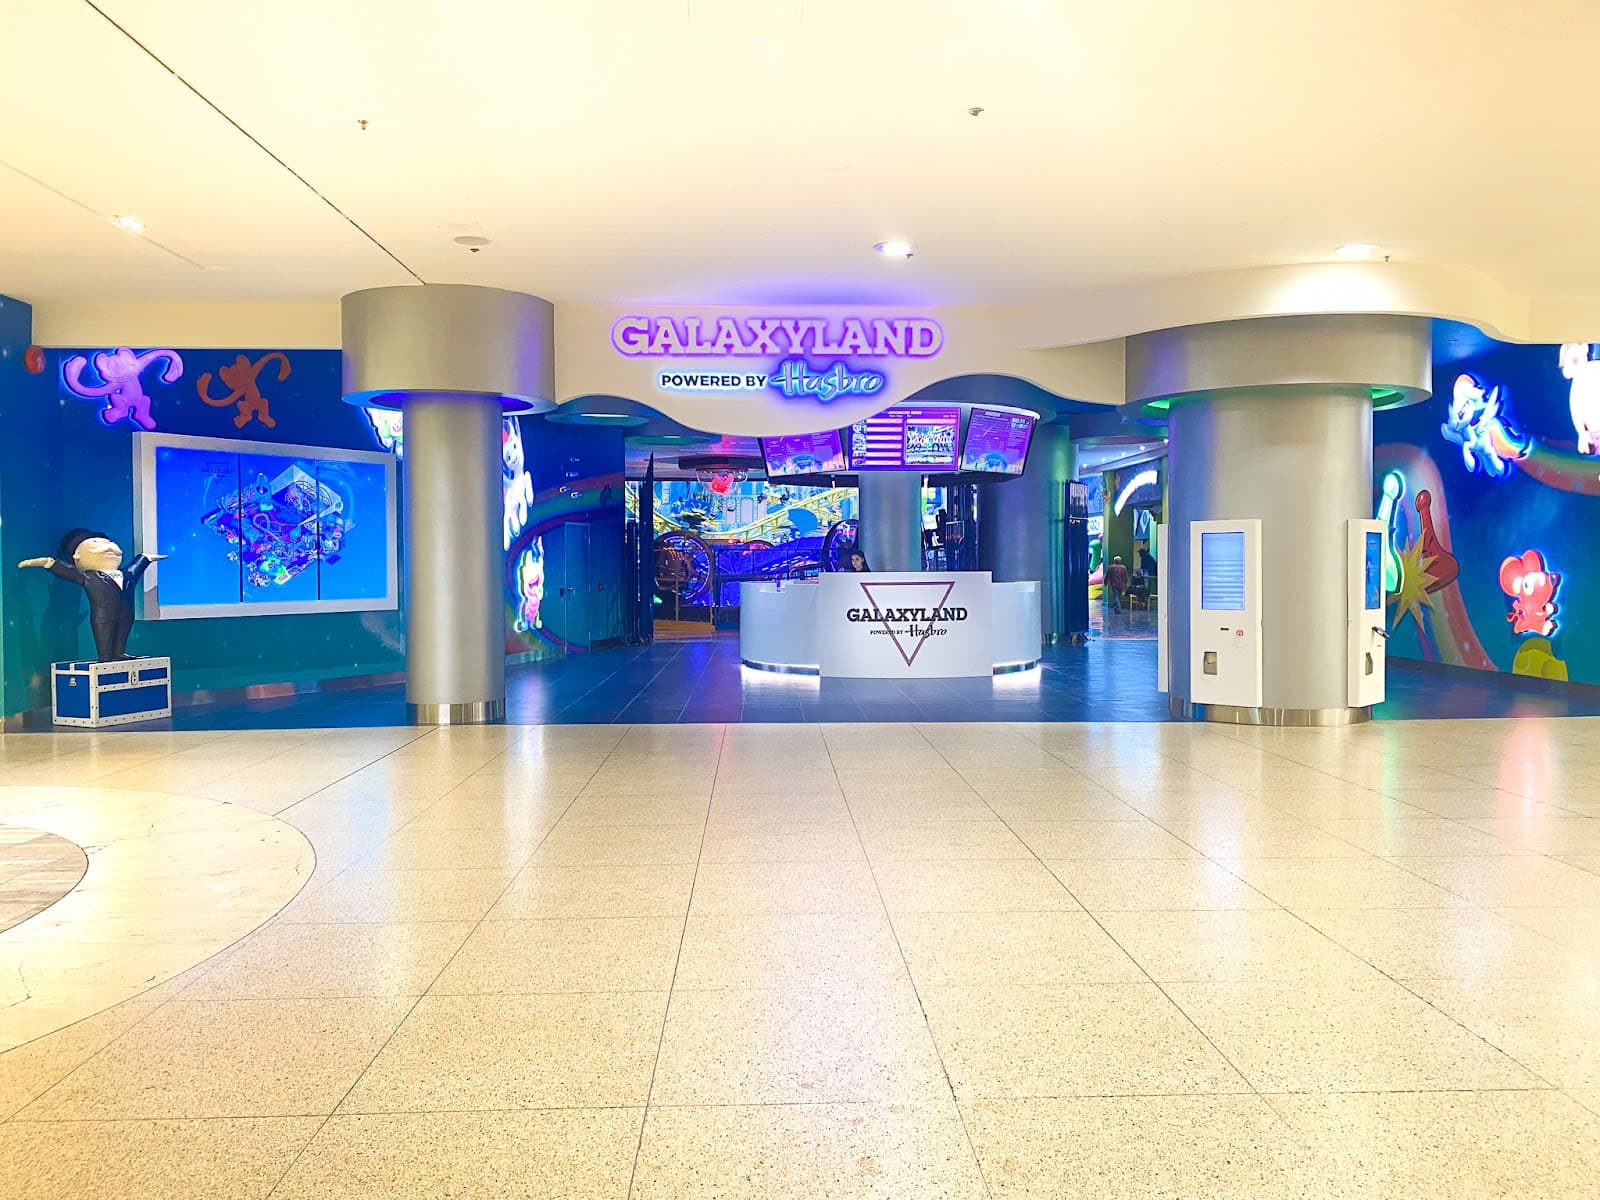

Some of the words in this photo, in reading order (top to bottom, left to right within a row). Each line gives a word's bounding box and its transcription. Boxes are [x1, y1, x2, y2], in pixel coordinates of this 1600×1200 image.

[613, 317, 942, 356] GALAXYLAND
[661, 374, 741, 387] POWERED
[745, 375, 767, 387] BY
[770, 360, 883, 399] Hasbro
[846, 607, 968, 622] GALAXYLAND
[904, 624, 948, 638] Hasbro
